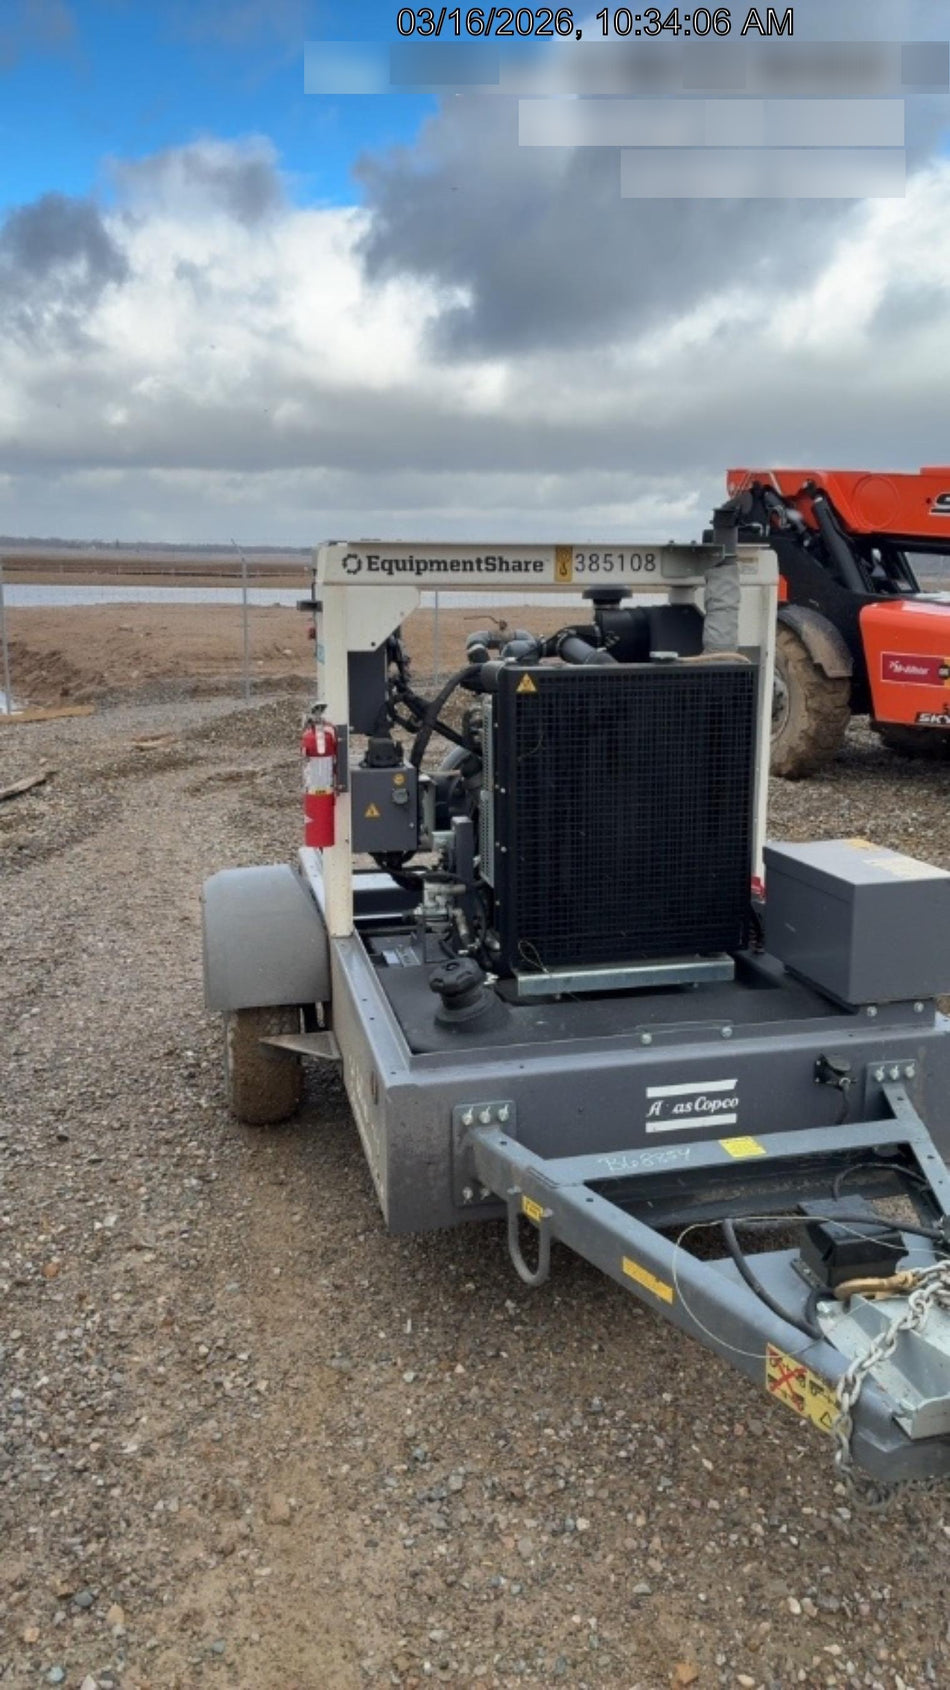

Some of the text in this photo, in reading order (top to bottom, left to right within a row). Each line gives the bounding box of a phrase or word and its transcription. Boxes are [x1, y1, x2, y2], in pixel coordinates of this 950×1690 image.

[366, 555, 544, 575] EquipmentShare
[574, 553, 657, 572] 385108
[646, 1096, 740, 1117] Aas Copco
